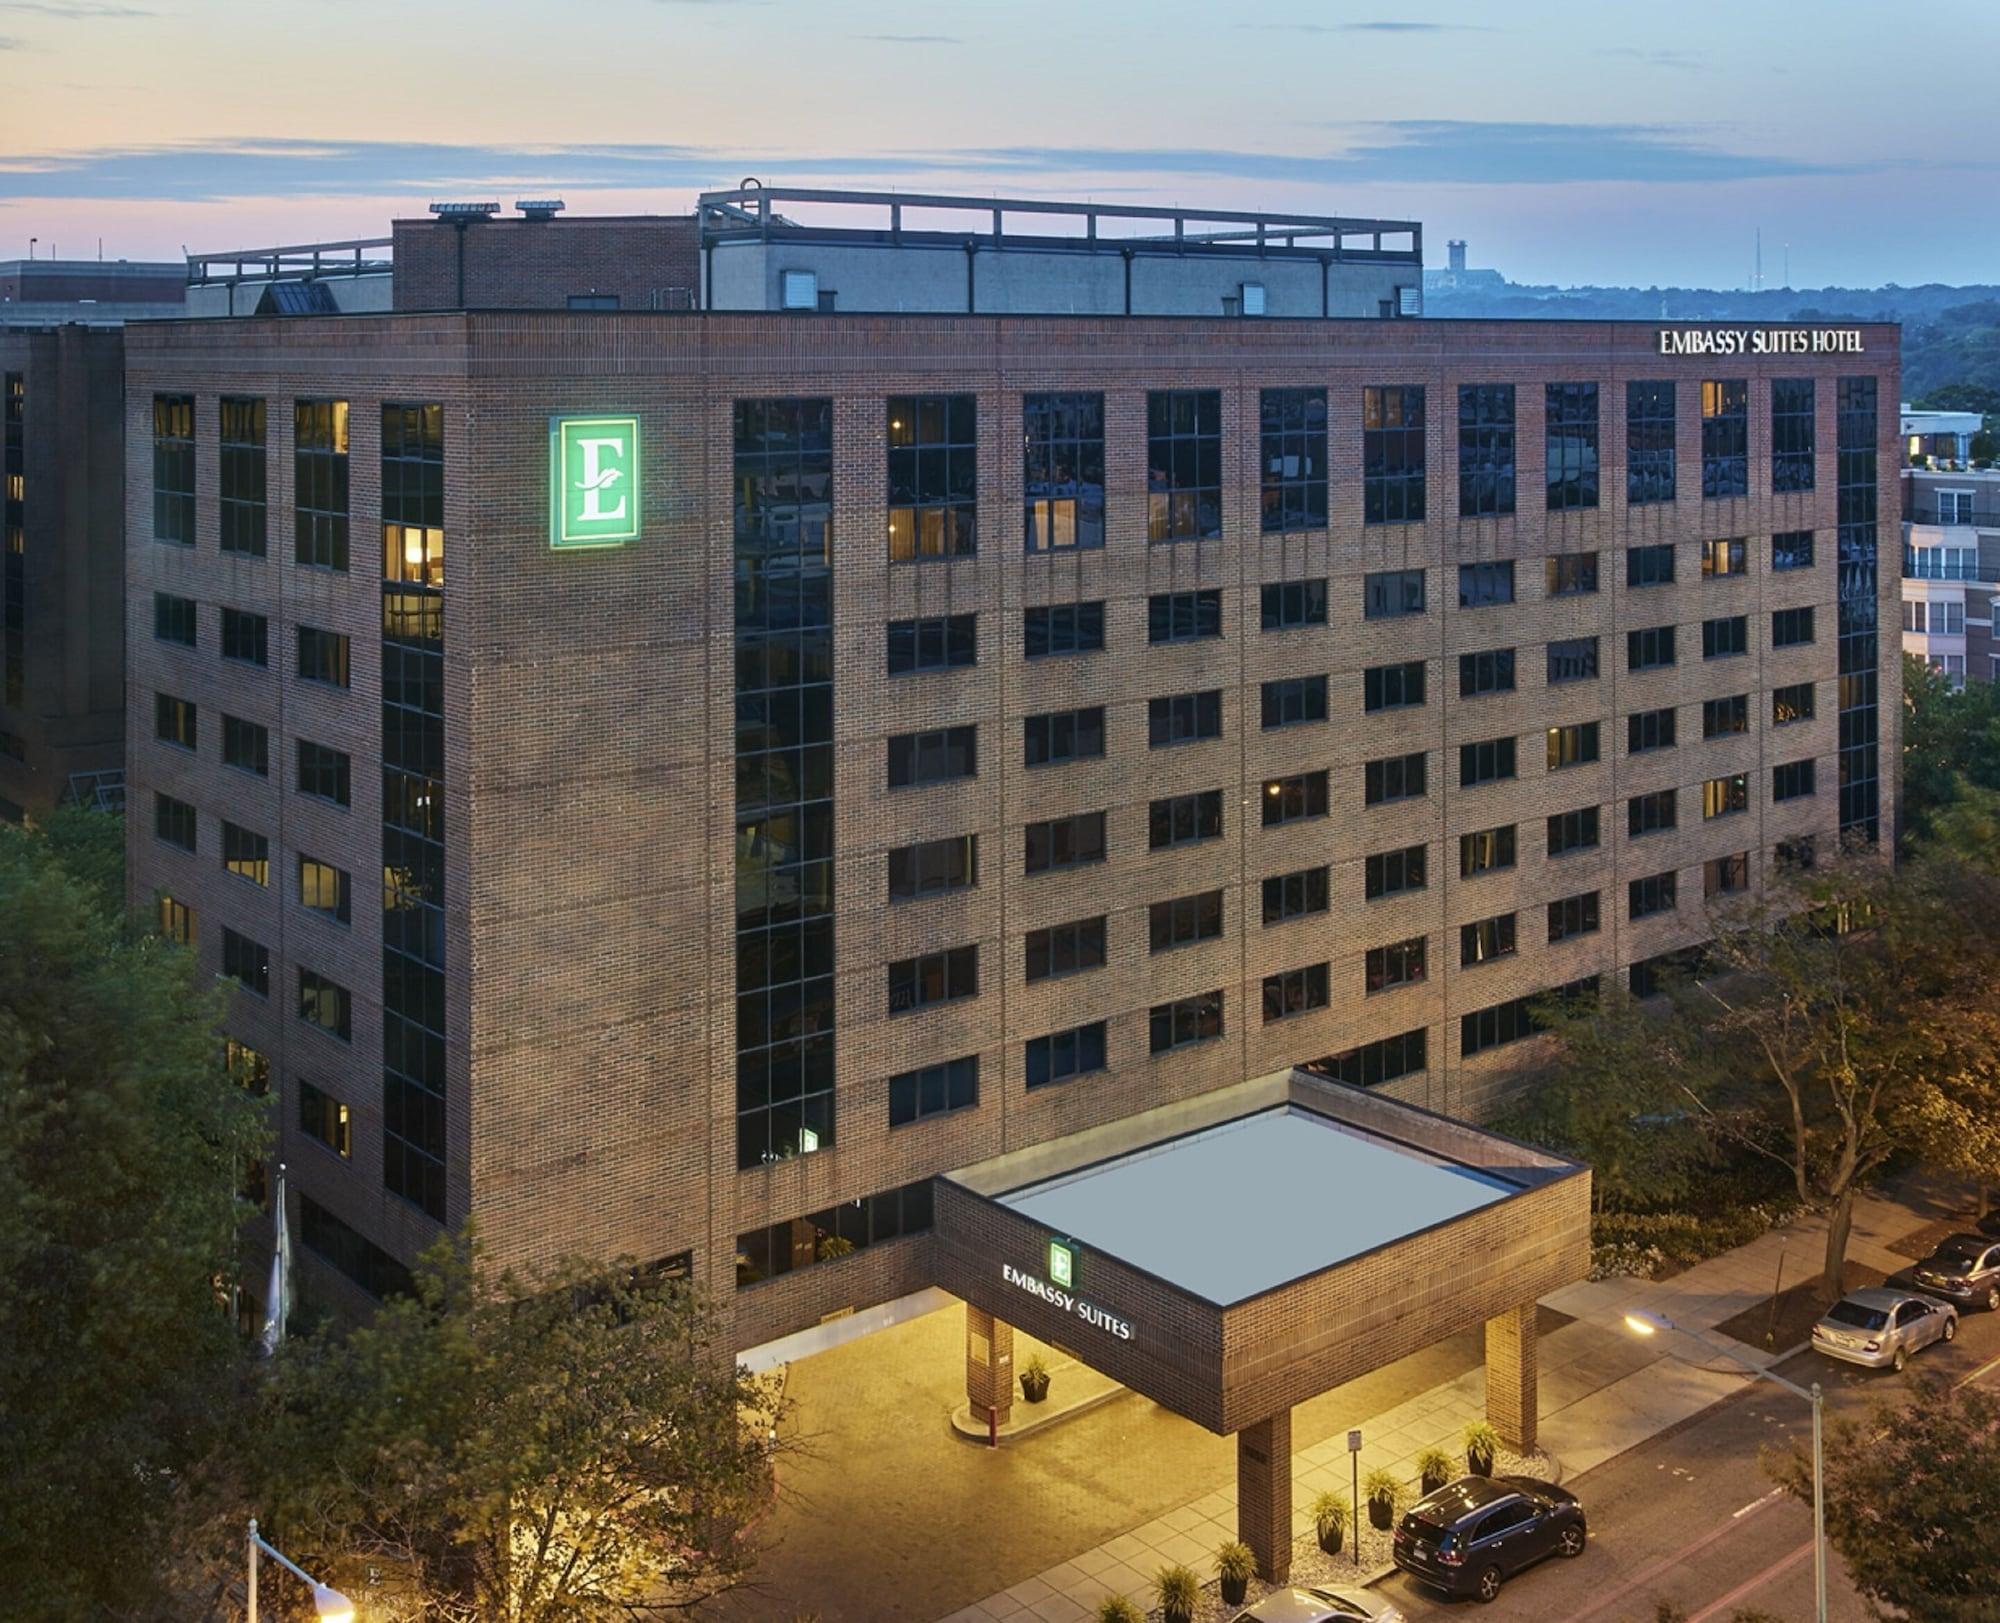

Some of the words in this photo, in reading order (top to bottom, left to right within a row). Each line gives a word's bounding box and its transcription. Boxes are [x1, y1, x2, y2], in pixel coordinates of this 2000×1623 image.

[1660, 329, 1748, 355] EMBASSY
[1752, 329, 1808, 354] SUITES
[1812, 329, 1865, 353] HOTEL
[574, 437, 626, 521] E
[1003, 1264, 1074, 1312] EMBASSY
[1078, 1302, 1131, 1340] SUITES
